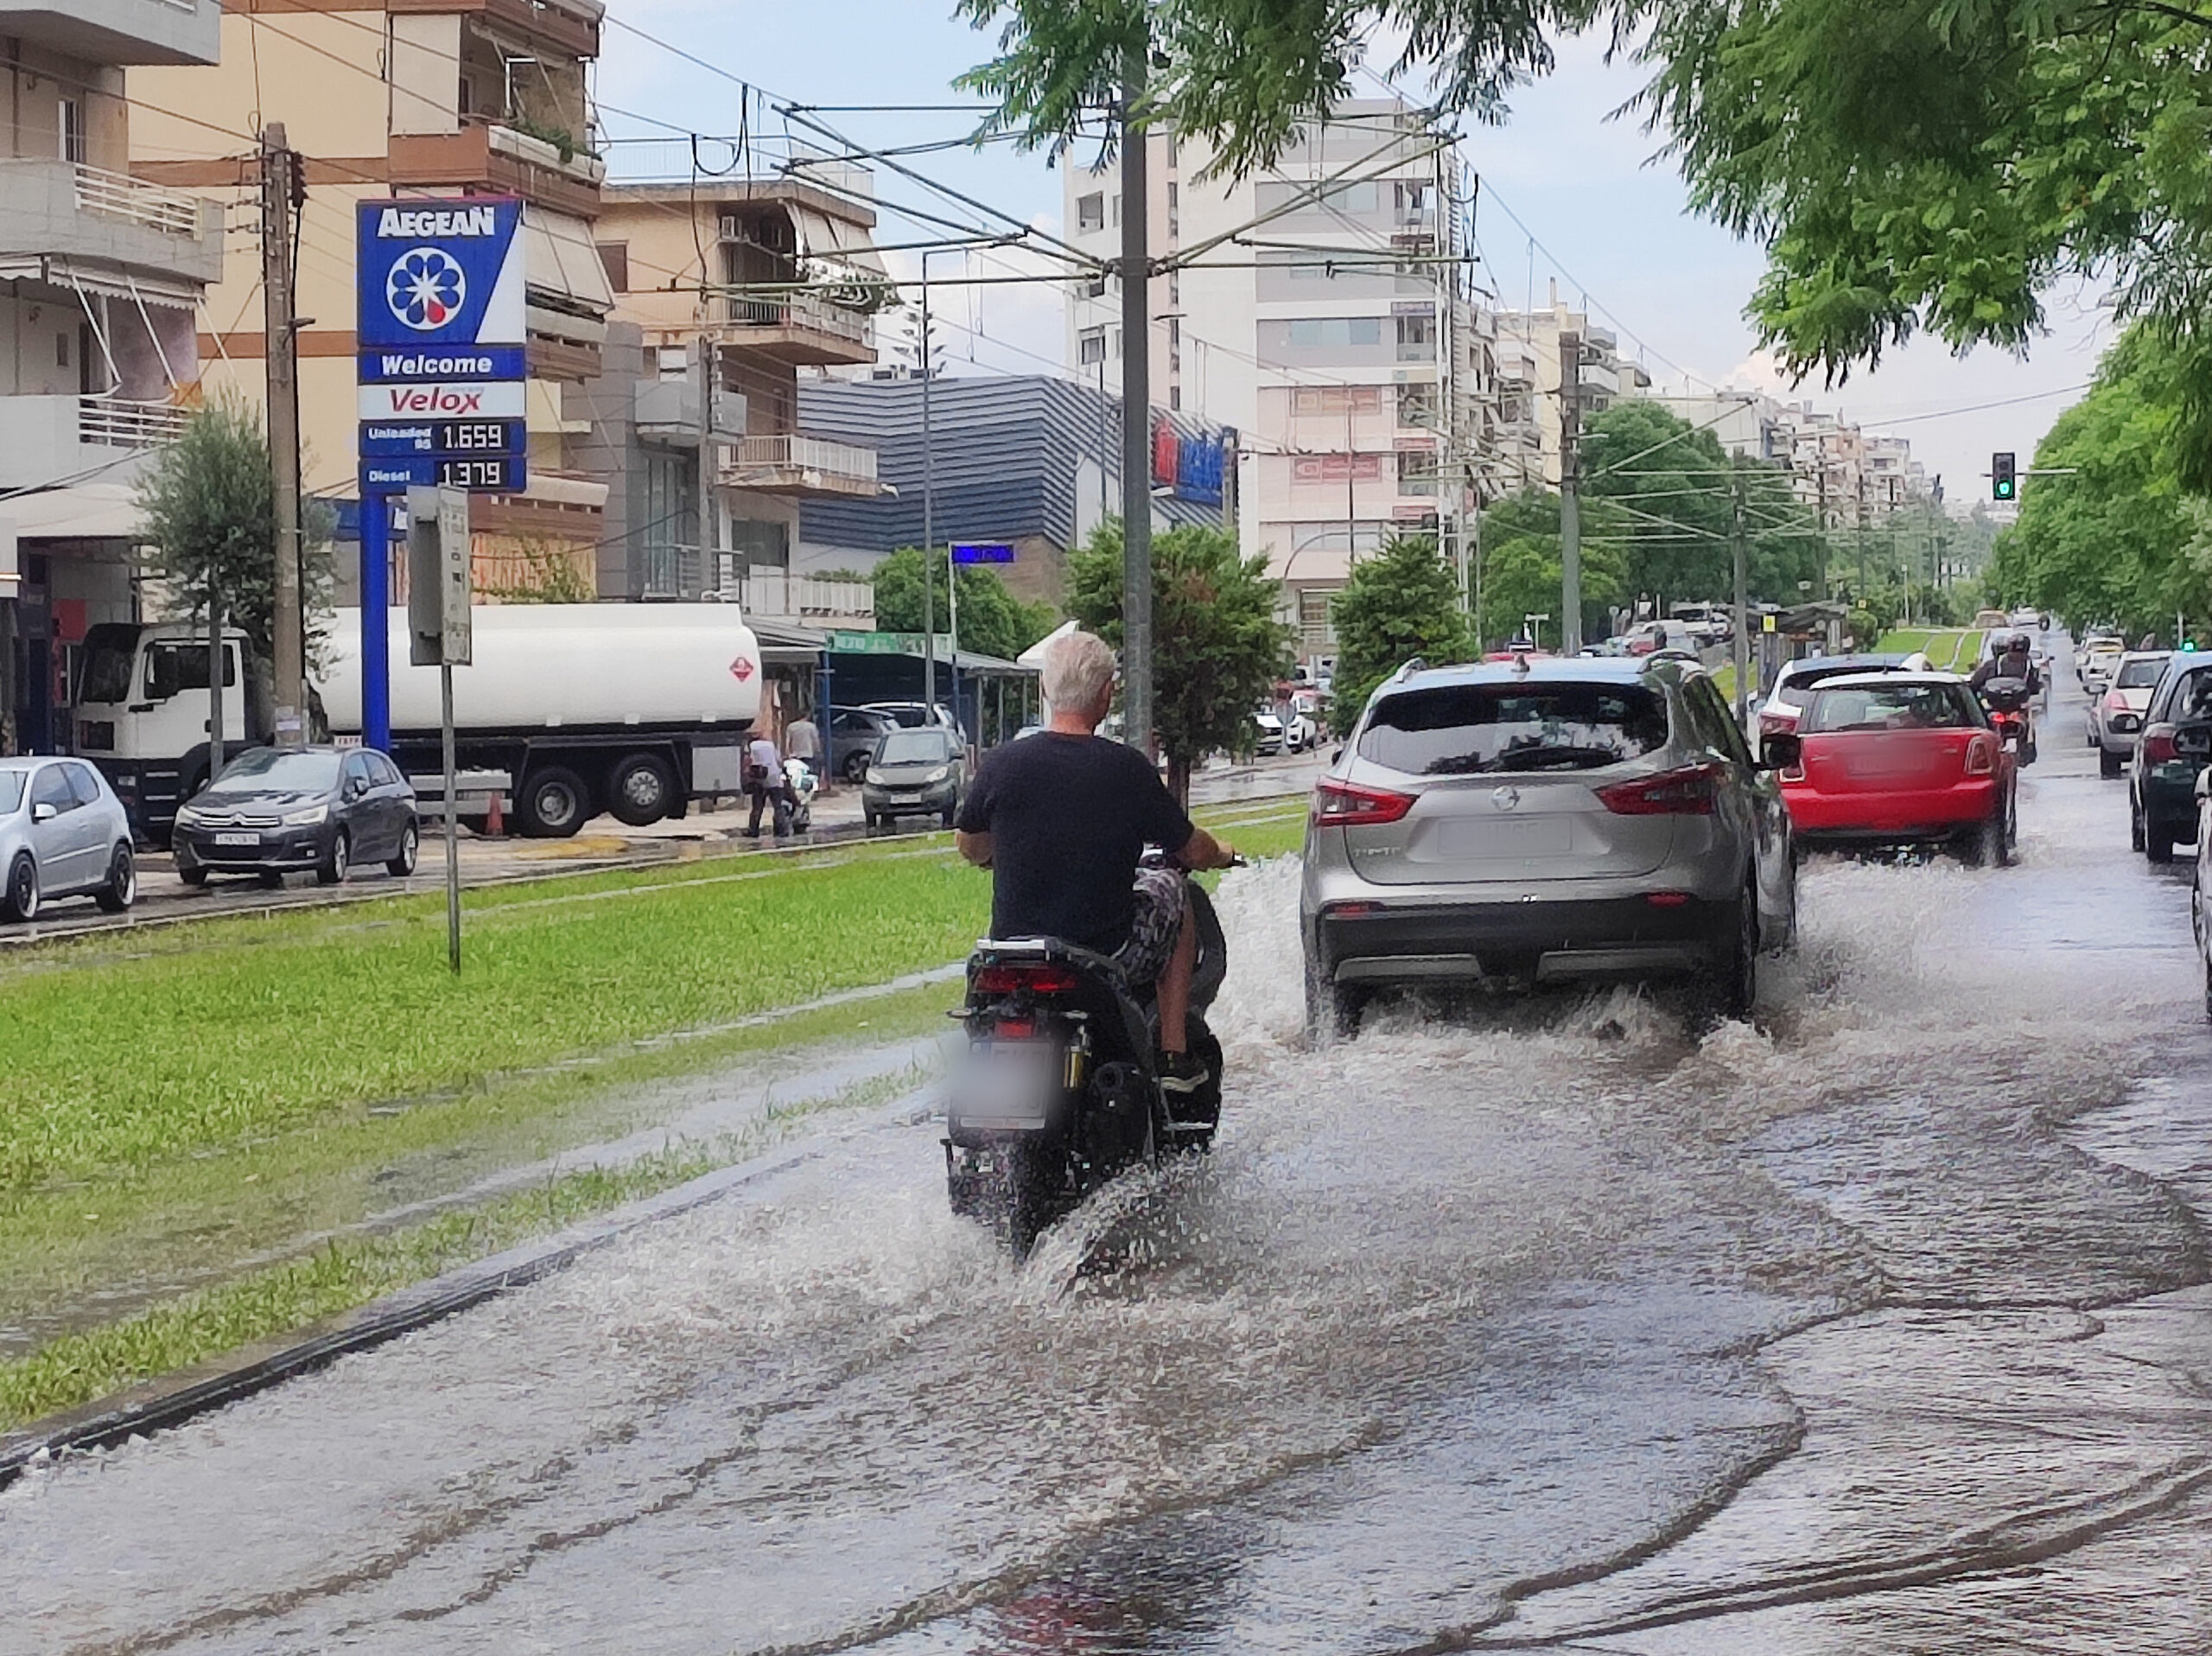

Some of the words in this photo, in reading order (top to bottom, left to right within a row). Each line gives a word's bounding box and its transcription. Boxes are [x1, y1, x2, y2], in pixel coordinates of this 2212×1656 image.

[377, 206, 495, 237] AEGEAN
[381, 354, 493, 376] Welcome
[390, 386, 483, 415] Velox
[443, 424, 502, 449] 1.659
[368, 469, 410, 482] Diesel
